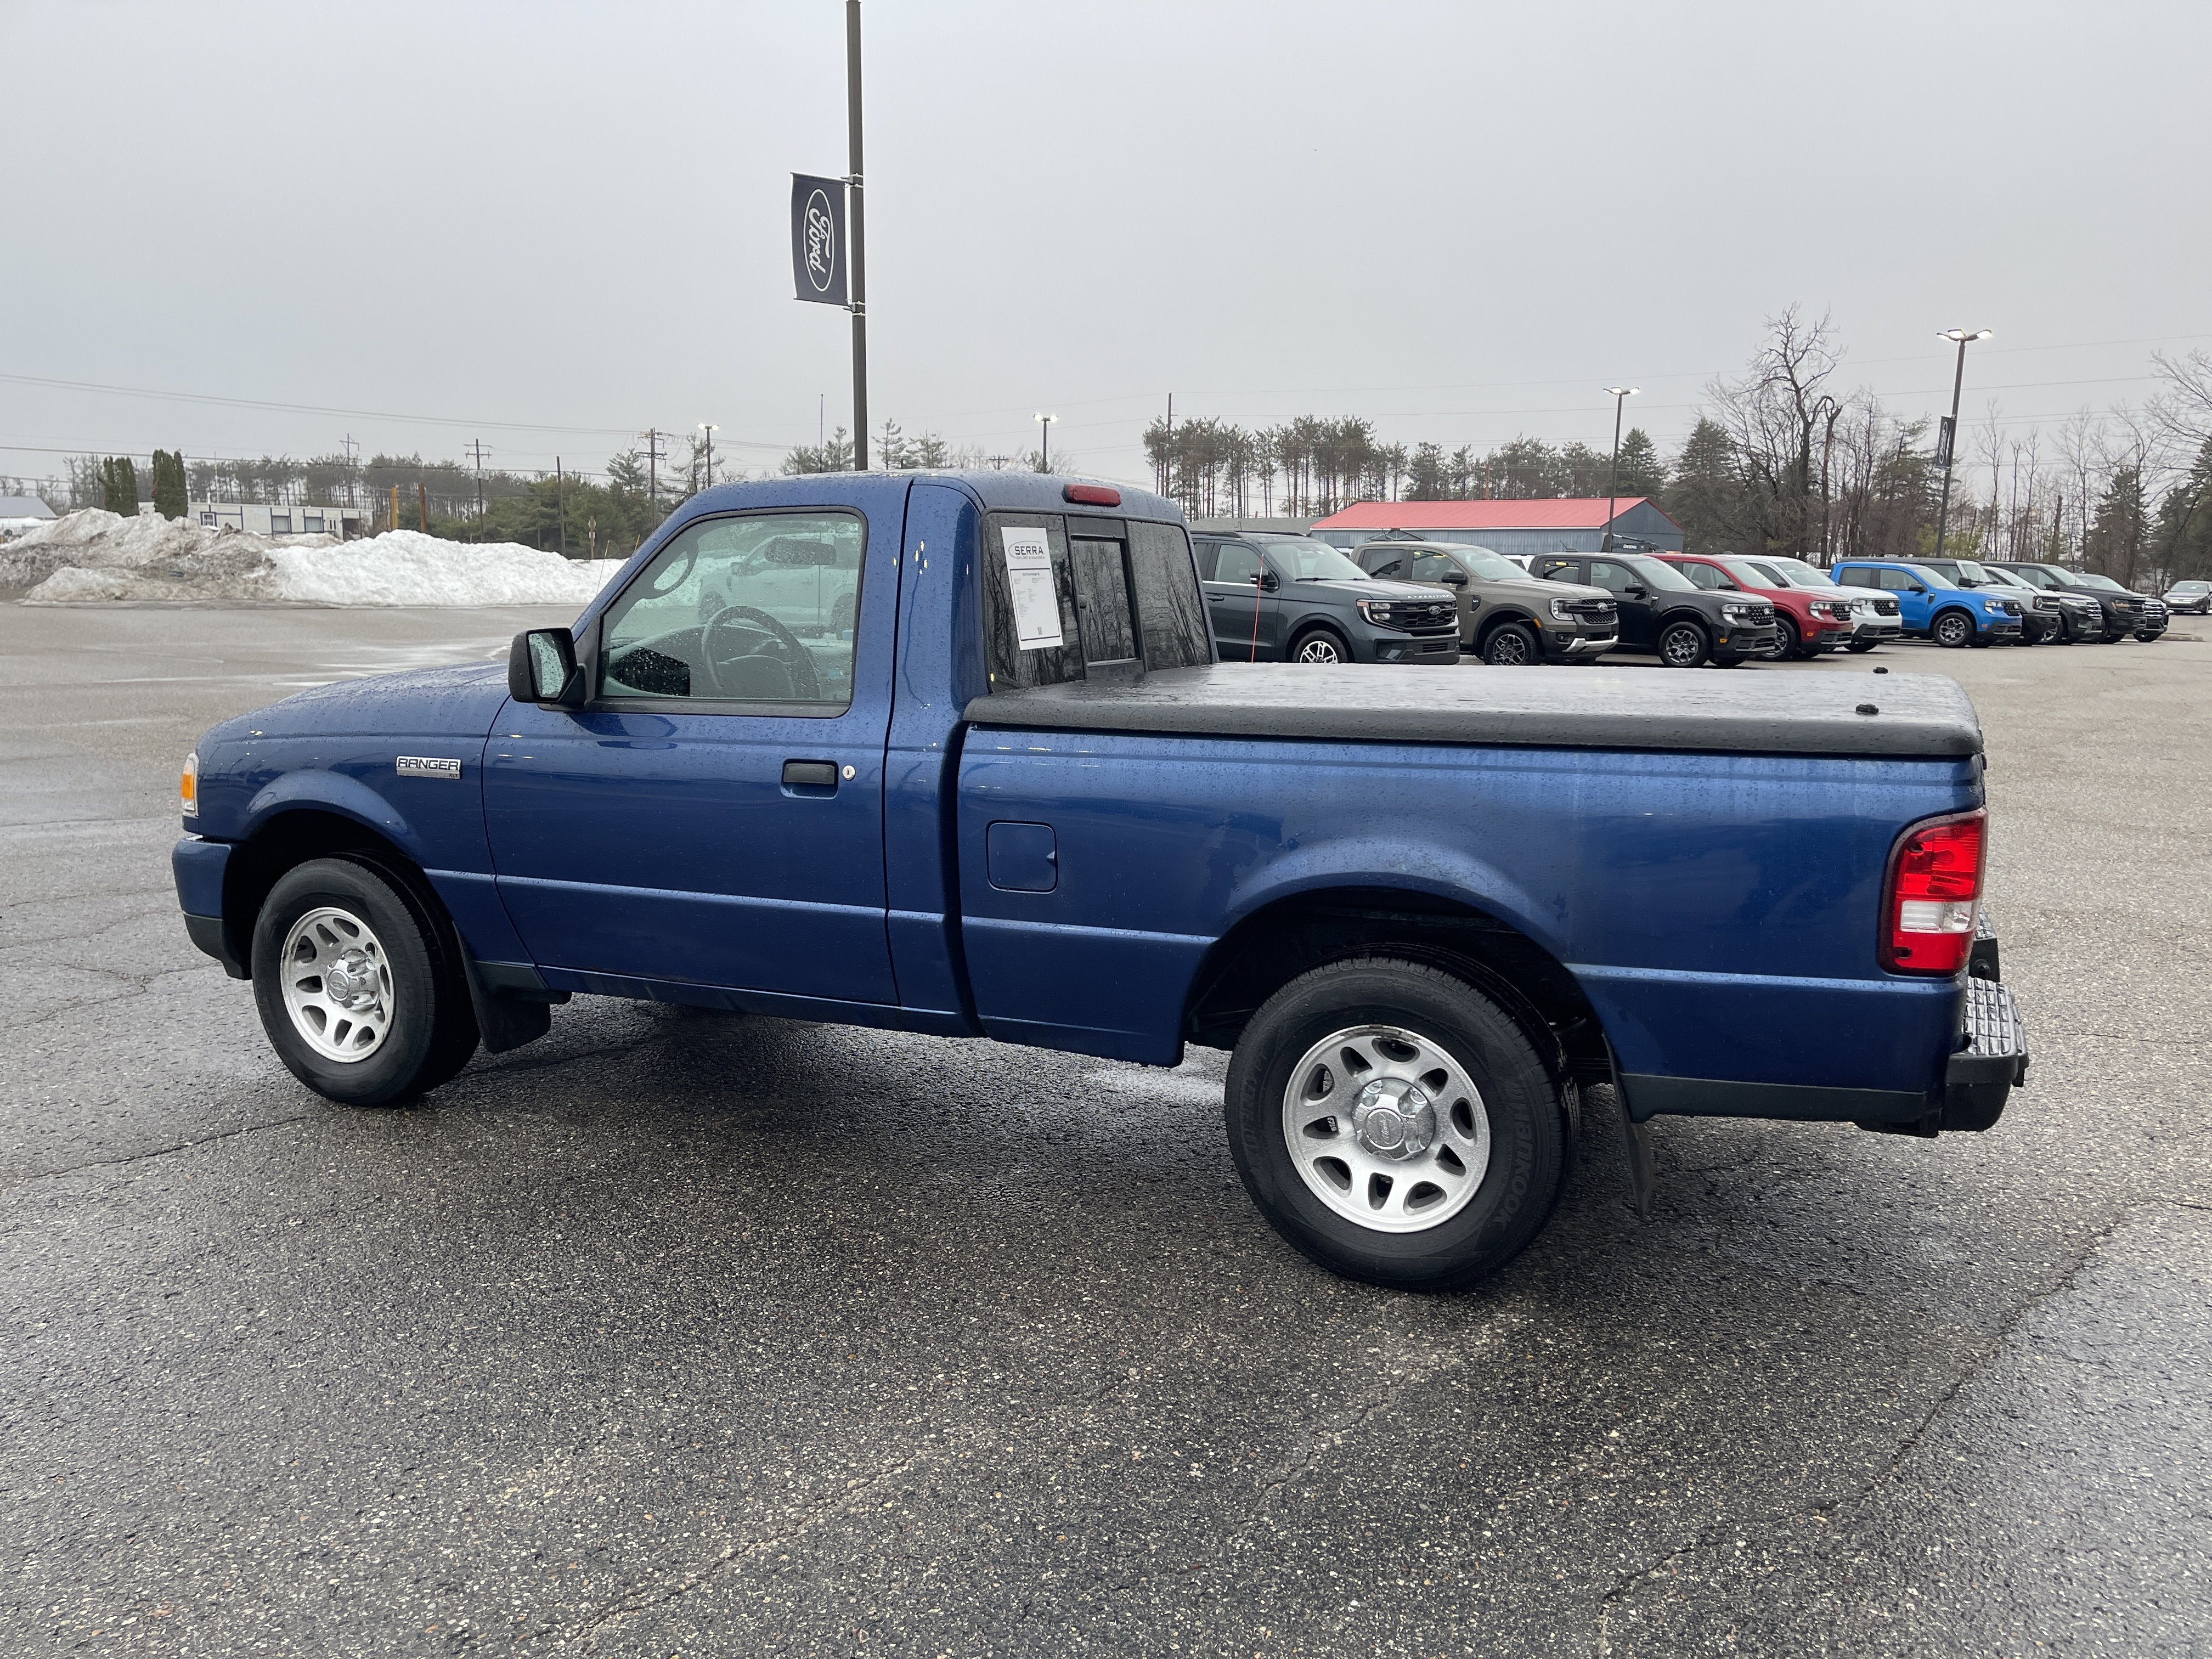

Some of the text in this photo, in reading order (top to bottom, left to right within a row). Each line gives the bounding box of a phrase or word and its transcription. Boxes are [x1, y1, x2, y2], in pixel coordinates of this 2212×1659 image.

[809, 208, 830, 273] Ford
[1015, 546, 1043, 555] SERRA
[398, 758, 459, 770] RANGER
